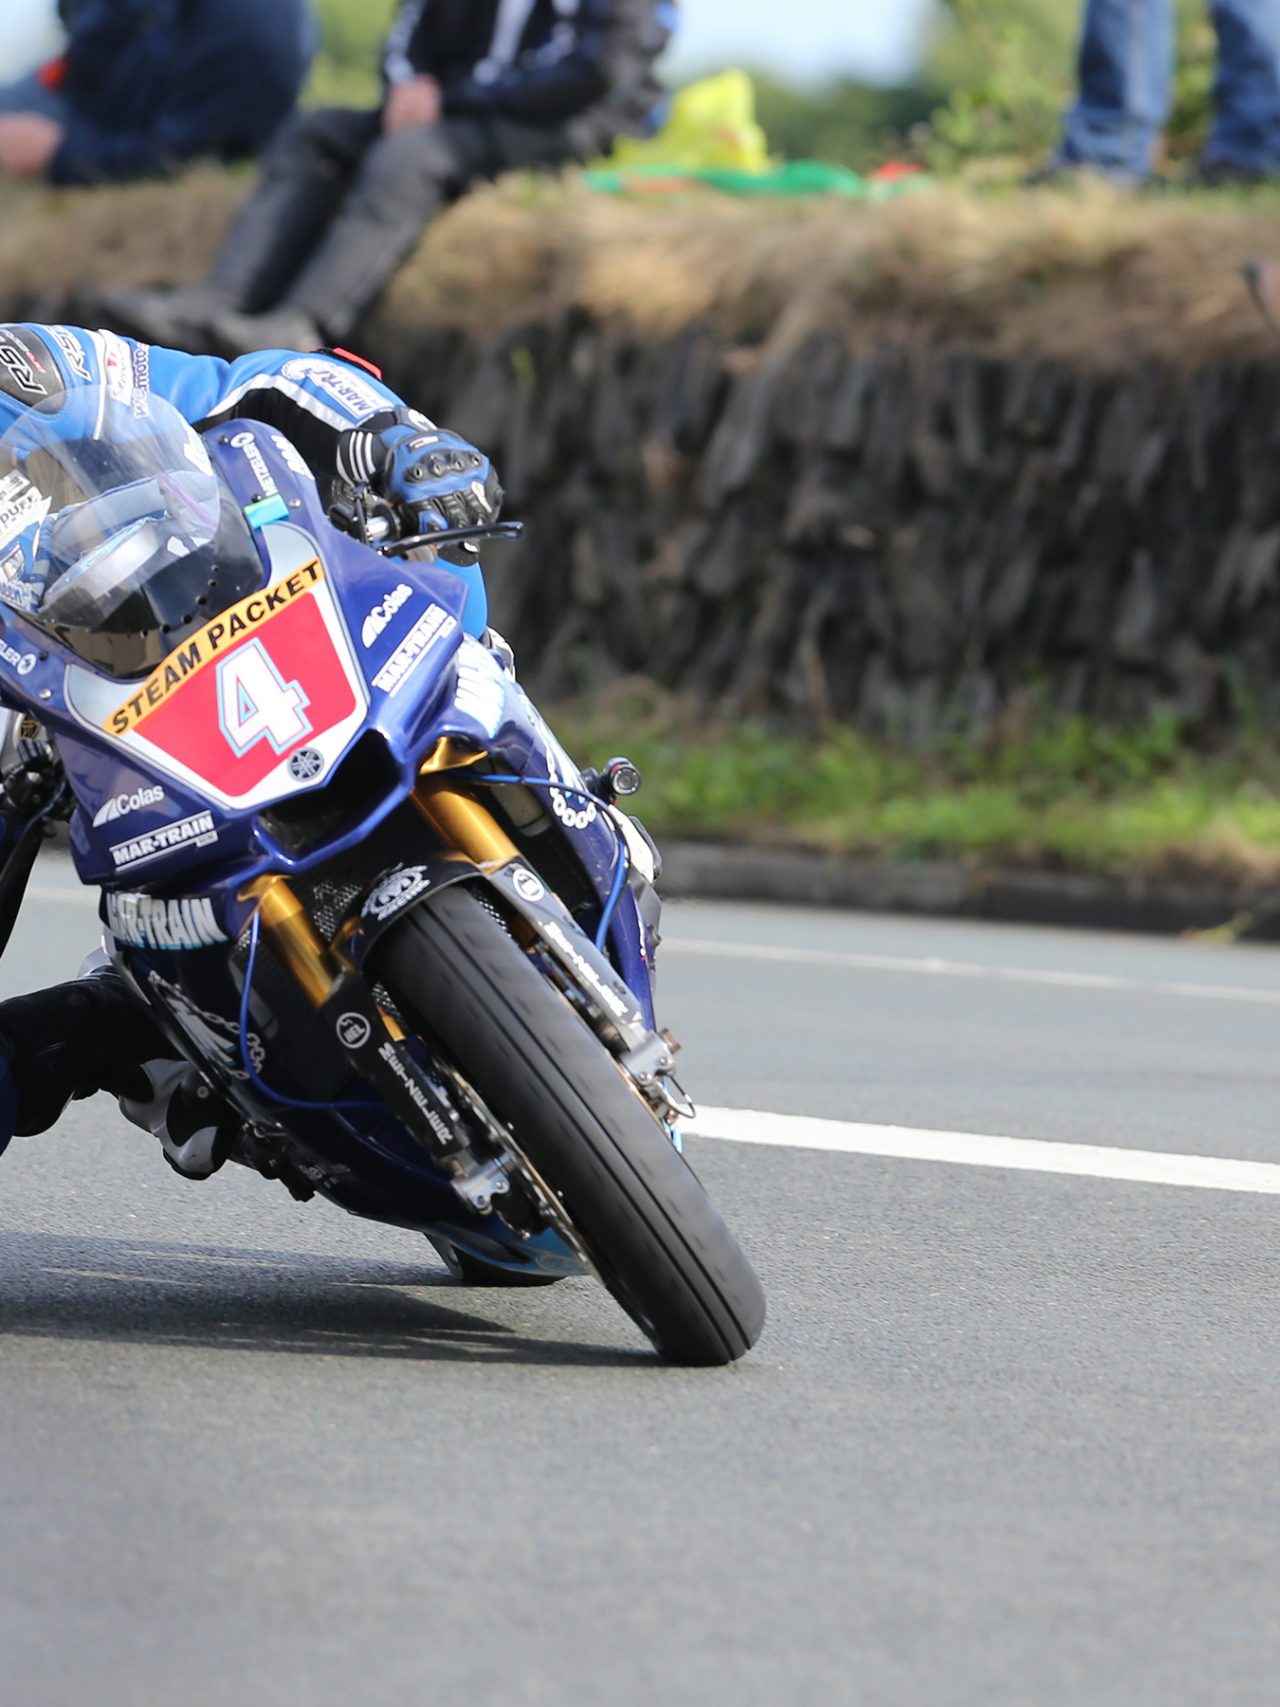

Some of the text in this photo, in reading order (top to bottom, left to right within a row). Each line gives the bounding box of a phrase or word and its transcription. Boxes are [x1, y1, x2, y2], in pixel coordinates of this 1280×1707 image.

[112, 560, 320, 734] STEAM PACKET
[216, 637, 313, 758] 4
[112, 814, 215, 866] MAR-TRAIN
[117, 786, 164, 815] Colas
